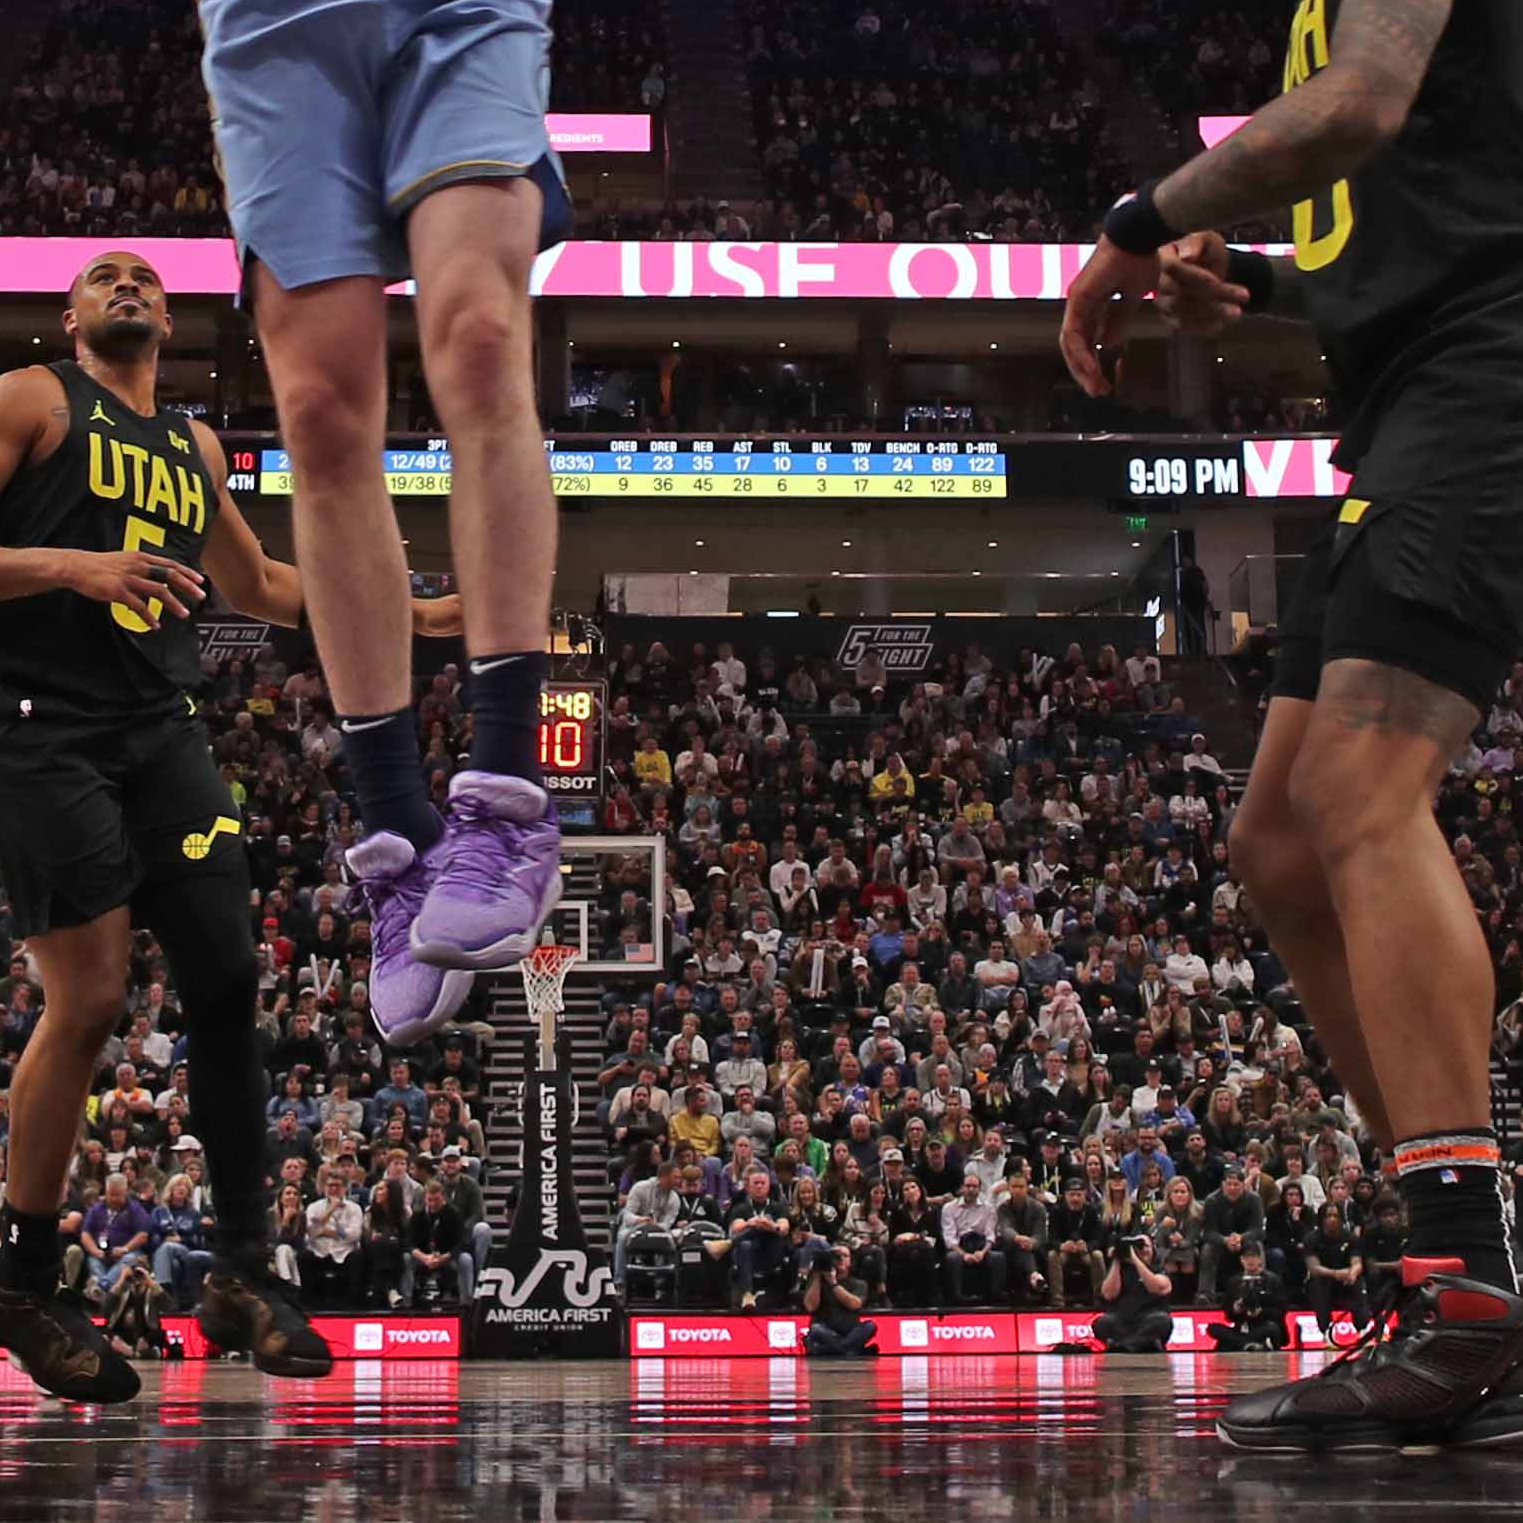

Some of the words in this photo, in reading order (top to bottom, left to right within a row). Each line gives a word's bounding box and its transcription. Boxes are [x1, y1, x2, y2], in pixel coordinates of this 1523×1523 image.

[427, 439, 448, 452] 3PT
[692, 440, 714, 453] REB
[732, 441, 754, 454] AST
[772, 441, 792, 454] STL
[811, 441, 832, 454] BLK
[885, 441, 921, 454] BENCH
[232, 452, 255, 471] 10
[390, 454, 437, 470] 12/49
[550, 455, 595, 472] (83%)
[614, 456, 633, 472] 12
[652, 456, 675, 471] 23
[692, 456, 715, 471] 35
[733, 456, 751, 471] 17
[773, 456, 792, 472] 10
[815, 457, 828, 472] 6
[851, 457, 870, 472] 13
[892, 457, 914, 472] 24
[931, 457, 953, 472] 89
[968, 457, 995, 472] 122
[88, 431, 207, 535] UTAH
[226, 474, 255, 491] 4TH
[390, 476, 436, 491] 19/38
[618, 477, 629, 492] 9
[653, 477, 674, 492] 36
[692, 477, 714, 492] 45
[733, 478, 753, 492] 28
[777, 478, 788, 492] 6
[816, 478, 827, 493] 3
[853, 478, 869, 493] 17
[893, 478, 914, 493] 42
[930, 478, 956, 493] 122
[972, 478, 993, 493] 89
[1129, 458, 1187, 495] 9:09
[1196, 458, 1240, 495] PM
[880, 630, 899, 641] FOR
[540, 721, 581, 767] 10
[539, 1082, 558, 1142] FIRST
[539, 1145, 558, 1241] AMERICA
[485, 1308, 560, 1323] AMERICA
[564, 1308, 612, 1323] FIRST
[387, 1329, 451, 1344] TOYOTA
[669, 1327, 732, 1342] TOYOTA
[932, 1325, 996, 1340] TOYOTA
